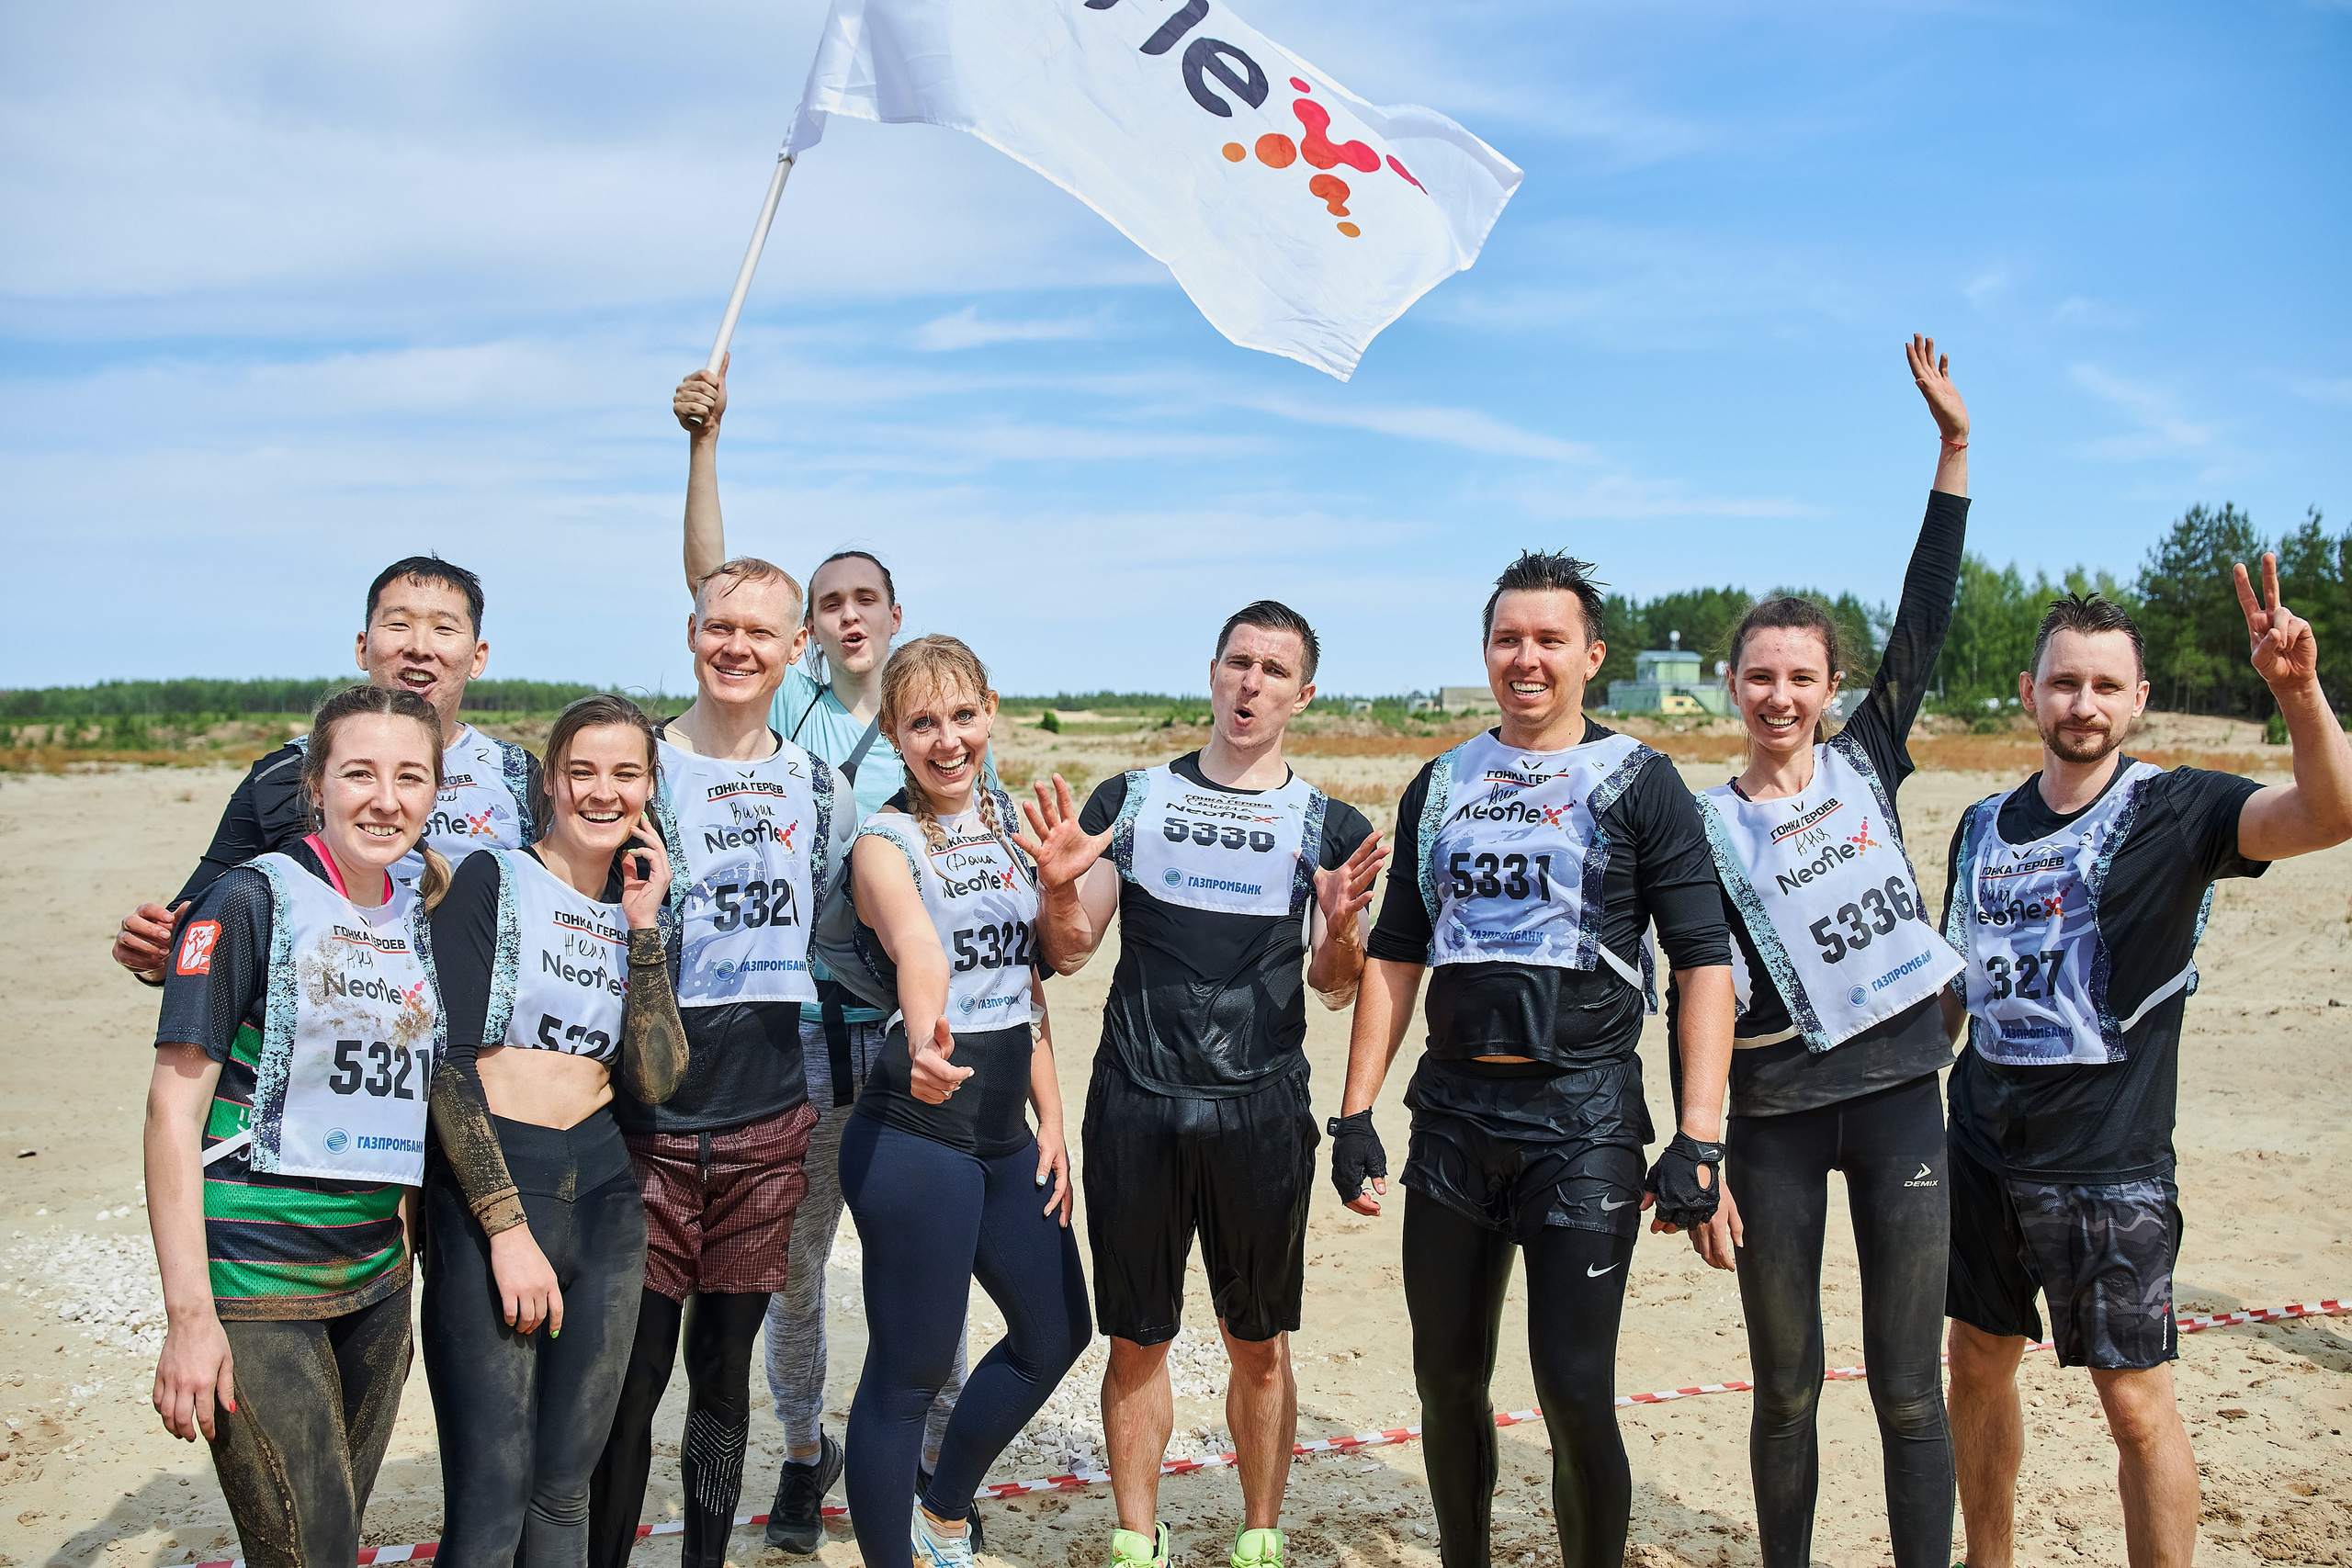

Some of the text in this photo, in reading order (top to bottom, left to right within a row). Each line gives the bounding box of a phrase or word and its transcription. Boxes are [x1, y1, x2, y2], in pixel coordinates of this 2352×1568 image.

[787, 761, 806, 779] 2
[1487, 770, 1526, 783] ГОНКА
[707, 782, 749, 798] ГОНКА
[422, 807, 499, 839] oflex
[1165, 802, 1284, 826] Neoflex
[1770, 797, 1838, 840] ГОНКА ГЕРОЕВ
[1163, 817, 1275, 852] 5330
[1775, 816, 1883, 897] Neoflex
[2017, 856, 2064, 873] ГЕРОЕВ
[942, 863, 1022, 898] Neoflex
[1188, 875, 1261, 896] ГАЗПРОМБАНК
[1449, 852, 1551, 901] 5331
[713, 878, 800, 932] 532
[1808, 875, 1916, 964] 5336
[1974, 883, 2074, 926] eoflex
[333, 925, 370, 942] ГОНКА
[554, 910, 628, 942] ГОНКА ГЕРО
[1471, 929, 1544, 942] ГАЗПРОМБАНК
[953, 920, 1030, 973] 5322
[1871, 949, 1932, 992] ГАЗПРОМБАН
[1979, 949, 2065, 1000] 327
[322, 970, 427, 1011] Neoflex
[2000, 1026, 2074, 1039] ГАЗПРОМБАНК
[328, 1040, 430, 1102] 5321
[1903, 1179, 1939, 1188] DEMIX
